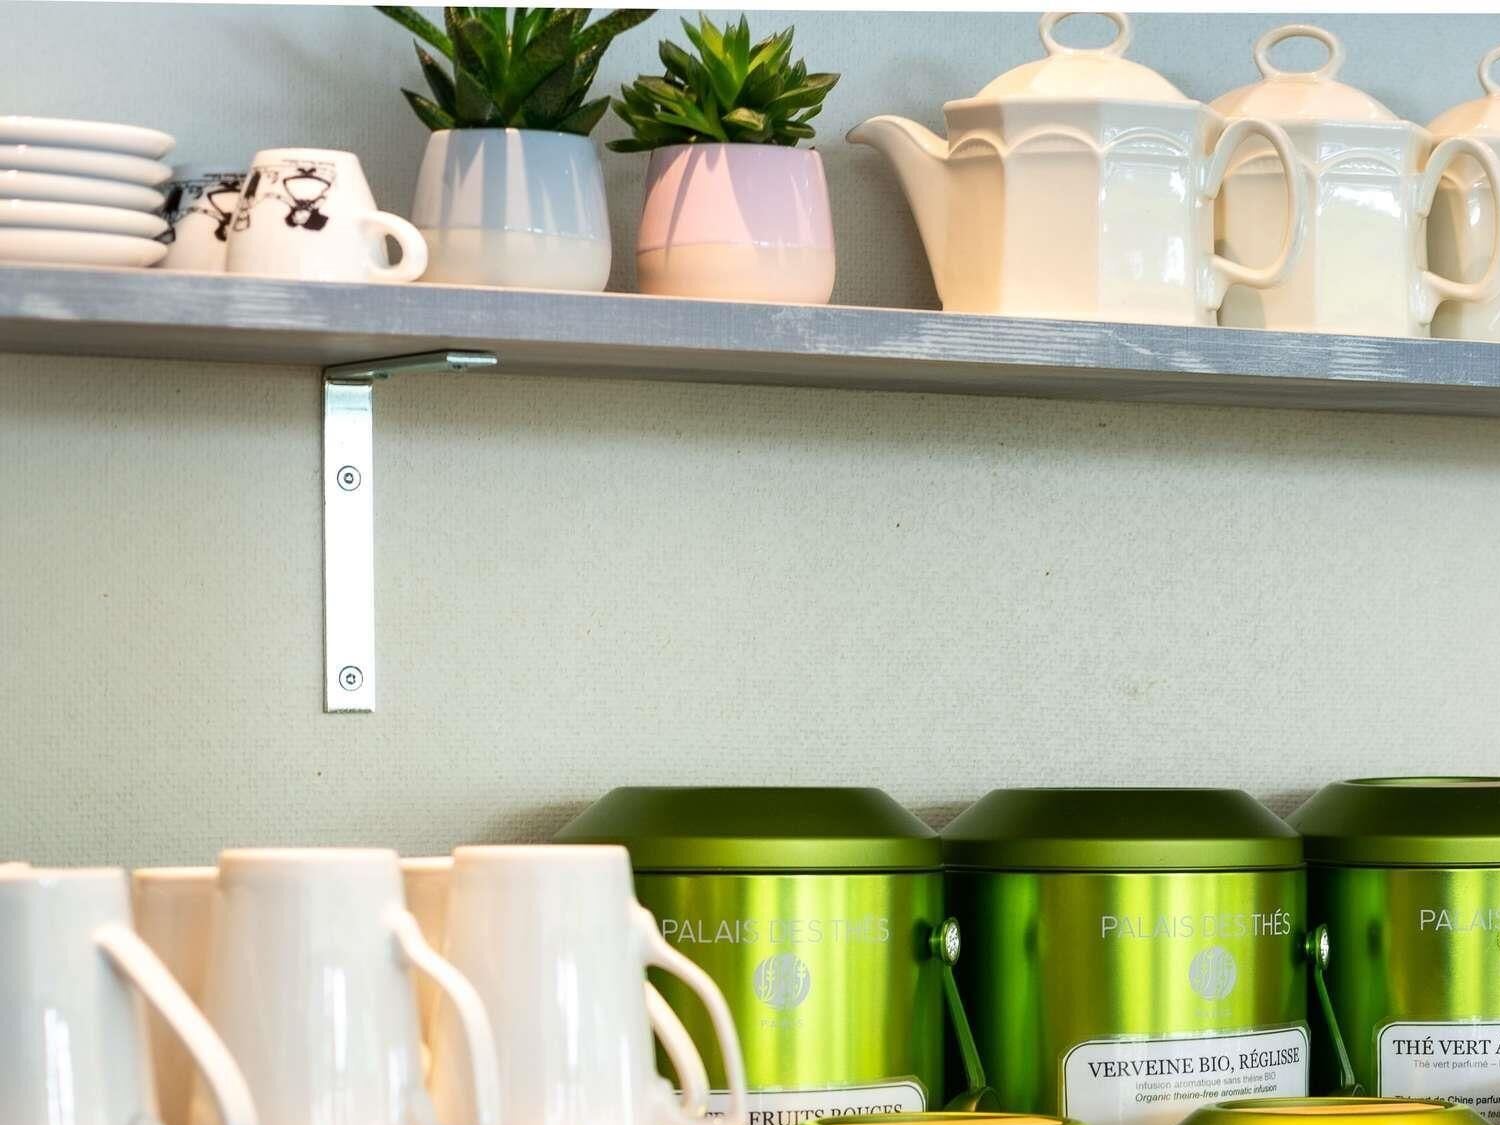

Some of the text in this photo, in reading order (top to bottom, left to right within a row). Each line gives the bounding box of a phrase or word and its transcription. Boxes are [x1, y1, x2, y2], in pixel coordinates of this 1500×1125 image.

[661, 911, 890, 944] PALAIS DES THÉS
[1101, 908, 1291, 939] PALAIS DES THÉS
[1392, 1036, 1434, 1055] THÉ
[1438, 1038, 1491, 1055] VERT
[1088, 1047, 1300, 1078] VERVEINE BIO, RÉGLISSE
[1414, 1059, 1431, 1069] Thé
[1433, 1059, 1451, 1069] vert
[1451, 1058, 1489, 1072] parfumé
[1136, 1081, 1172, 1091] Infusion
[1174, 1078, 1222, 1091] aromatique
[1223, 1077, 1241, 1086] sans
[1264, 1071, 1276, 1081] BIO
[1135, 1092, 1171, 1104] Organic
[1221, 1086, 1252, 1098] aromatic
[1253, 1083, 1277, 1095] infusion
